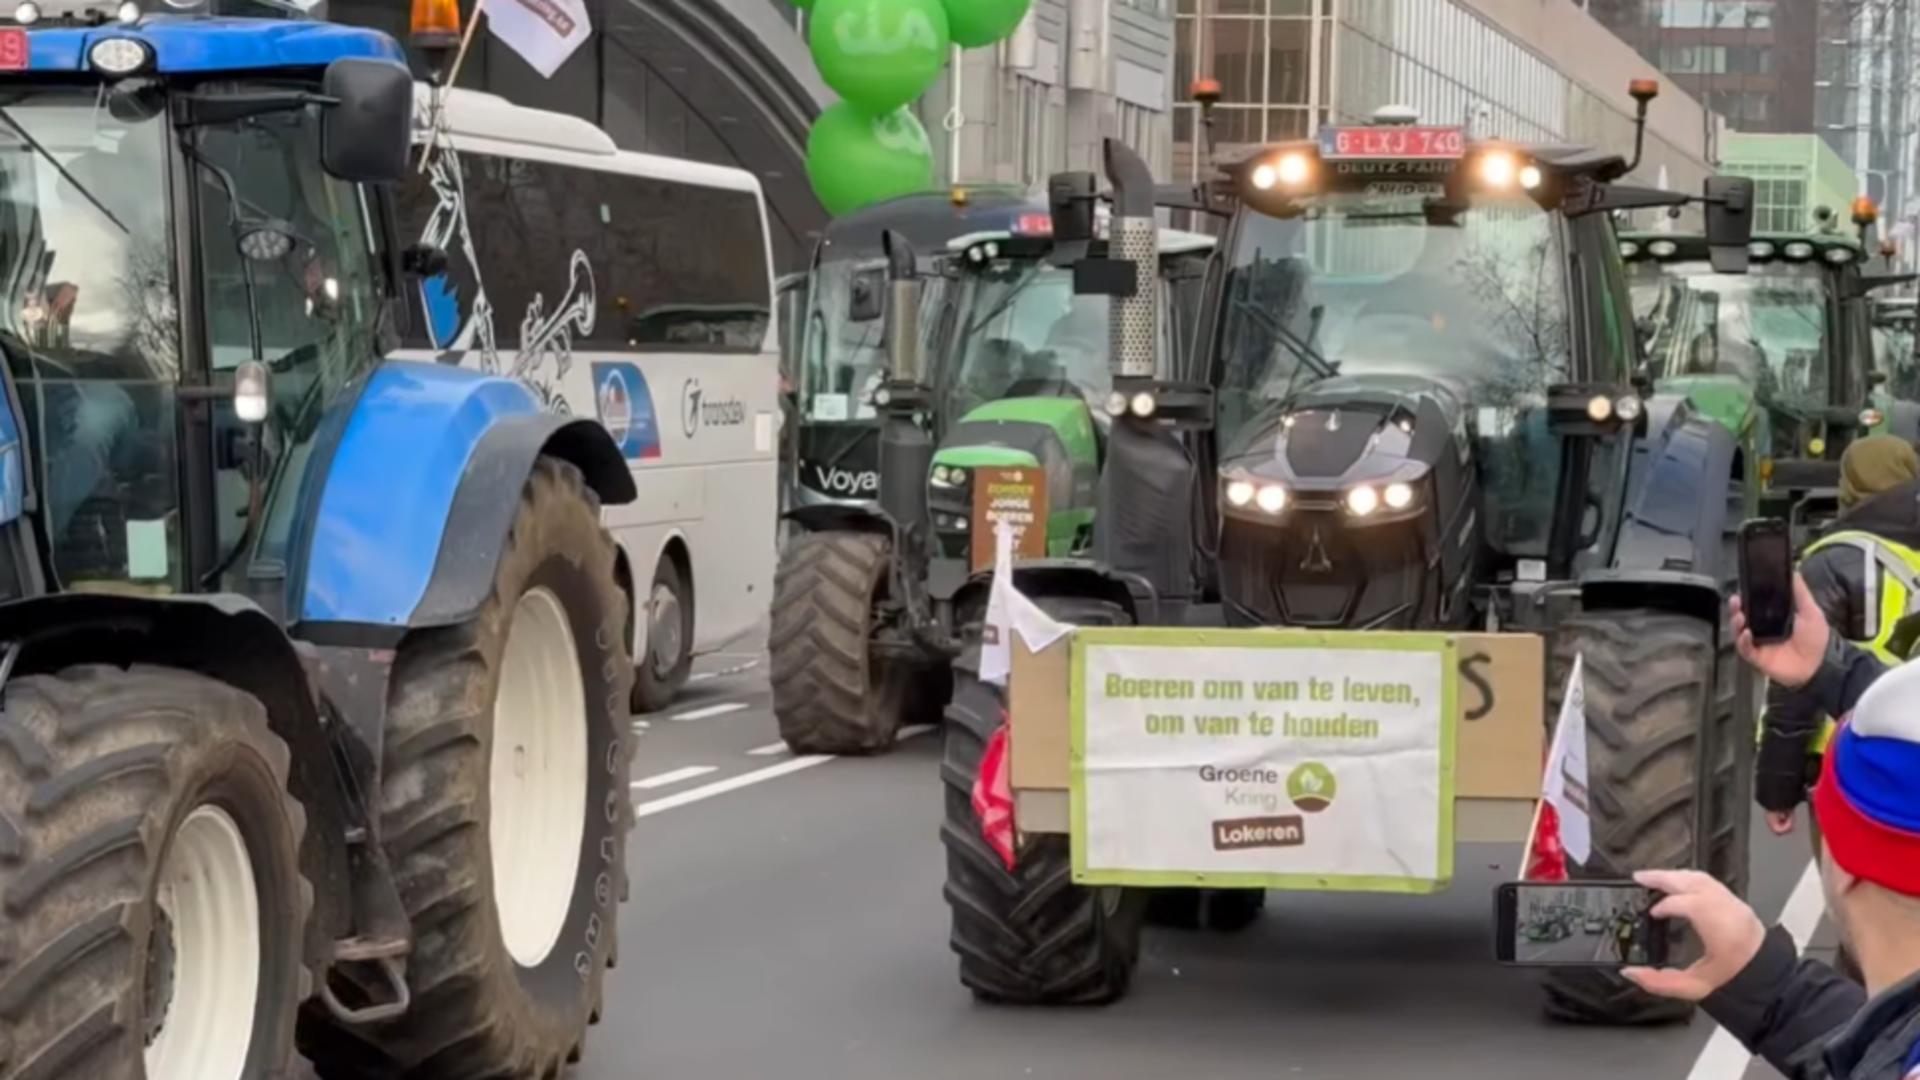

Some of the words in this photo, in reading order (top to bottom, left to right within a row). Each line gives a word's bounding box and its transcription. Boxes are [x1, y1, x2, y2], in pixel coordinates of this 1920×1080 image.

[815, 465, 881, 495] Voya
[1104, 672, 1194, 699] Boeren
[1203, 679, 1243, 700] om
[1253, 678, 1299, 700] van
[1308, 676, 1334, 701] te
[1343, 676, 1421, 707] leven,
[1145, 713, 1184, 735] om
[1194, 714, 1239, 737] van
[1249, 711, 1274, 737] te
[1282, 711, 1379, 739] houden
[1199, 764, 1278, 784] Groene
[1225, 786, 1277, 812] Kring
[1218, 824, 1299, 844] Lokeren
